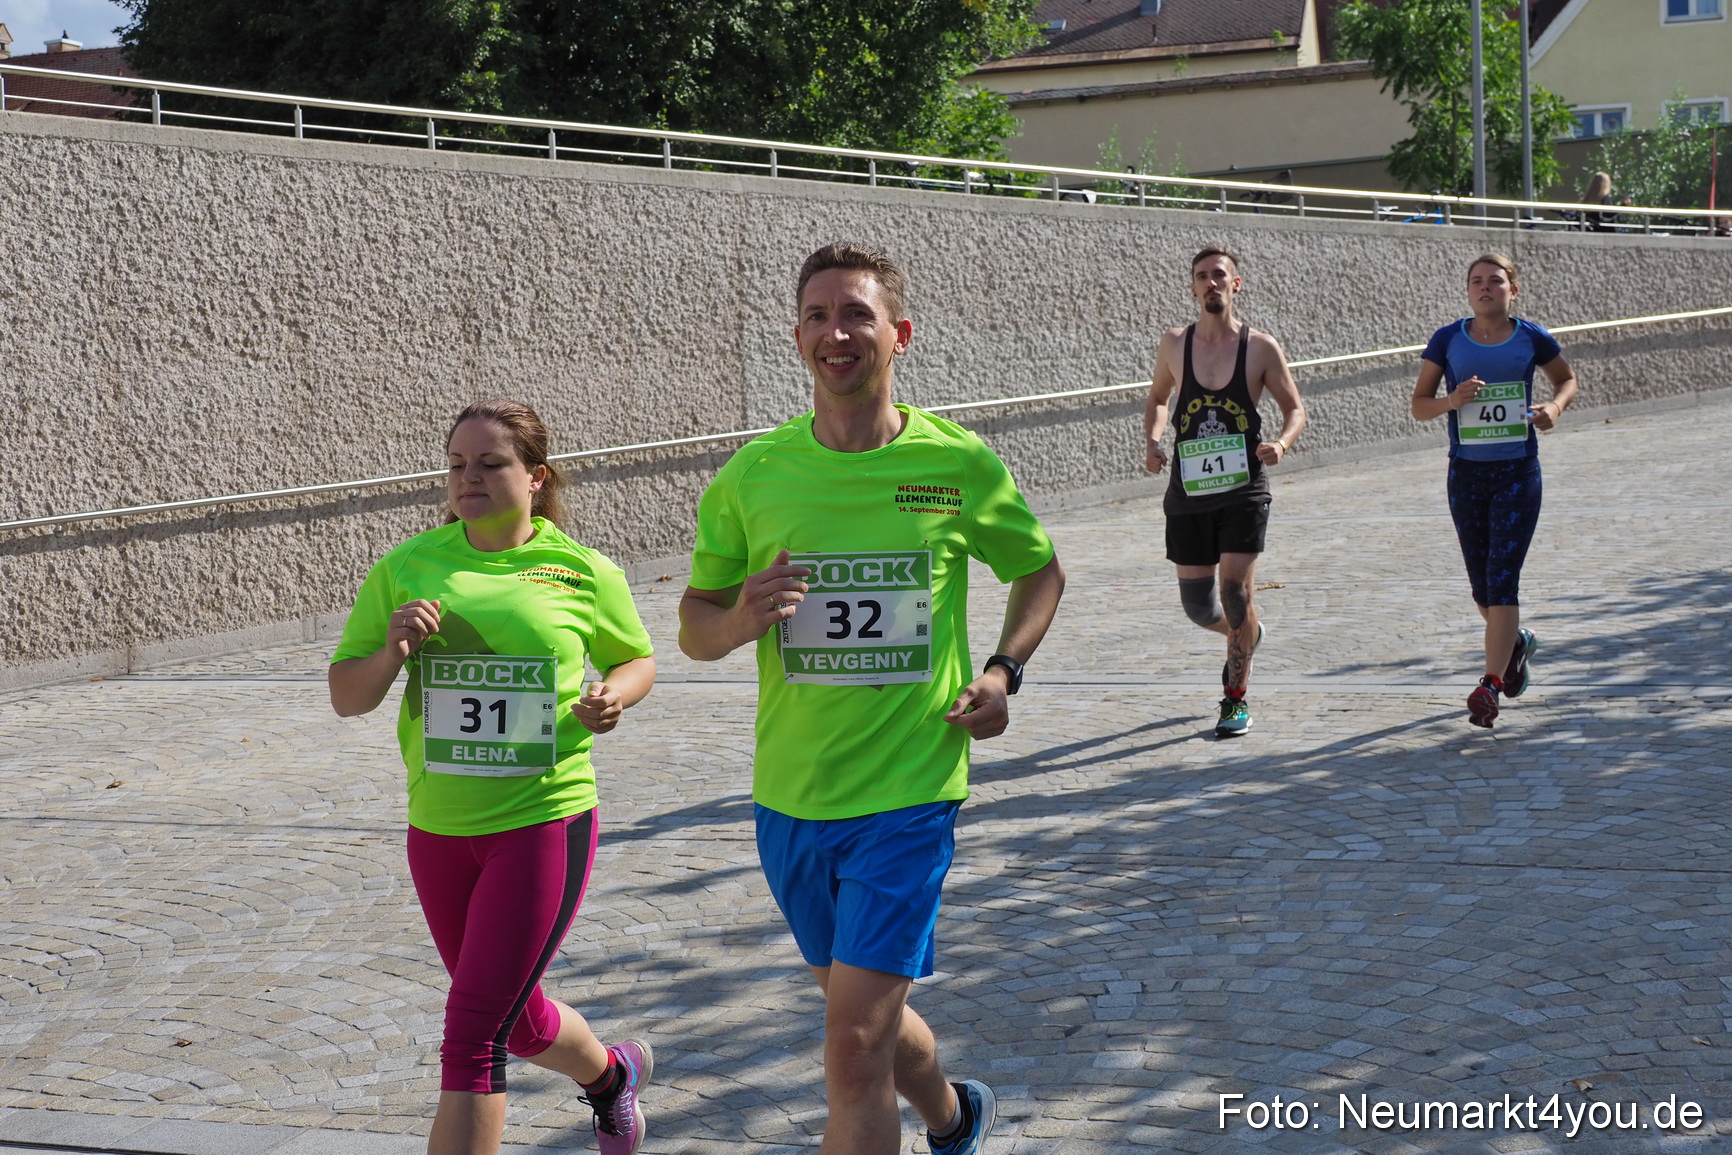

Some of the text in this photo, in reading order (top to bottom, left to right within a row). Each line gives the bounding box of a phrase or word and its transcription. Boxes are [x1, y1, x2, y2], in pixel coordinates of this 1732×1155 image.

[1475, 385, 1520, 400] OCK
[1479, 404, 1506, 422] 40
[1478, 428, 1509, 437] JULIA
[1183, 437, 1239, 456] BOCK
[1202, 455, 1225, 474] 41
[897, 485, 960, 496] NEUMARKTER
[1197, 476, 1235, 489] NIKLAS
[895, 494, 963, 507] ELEMENTELAUF
[910, 506, 945, 514] September
[946, 508, 960, 516] 2019
[529, 578, 562, 590] September
[826, 600, 883, 639] 32
[799, 651, 913, 670] YEVGENIY
[431, 660, 545, 688] BOCK
[460, 698, 507, 734] 31
[452, 745, 518, 762] ELENA
